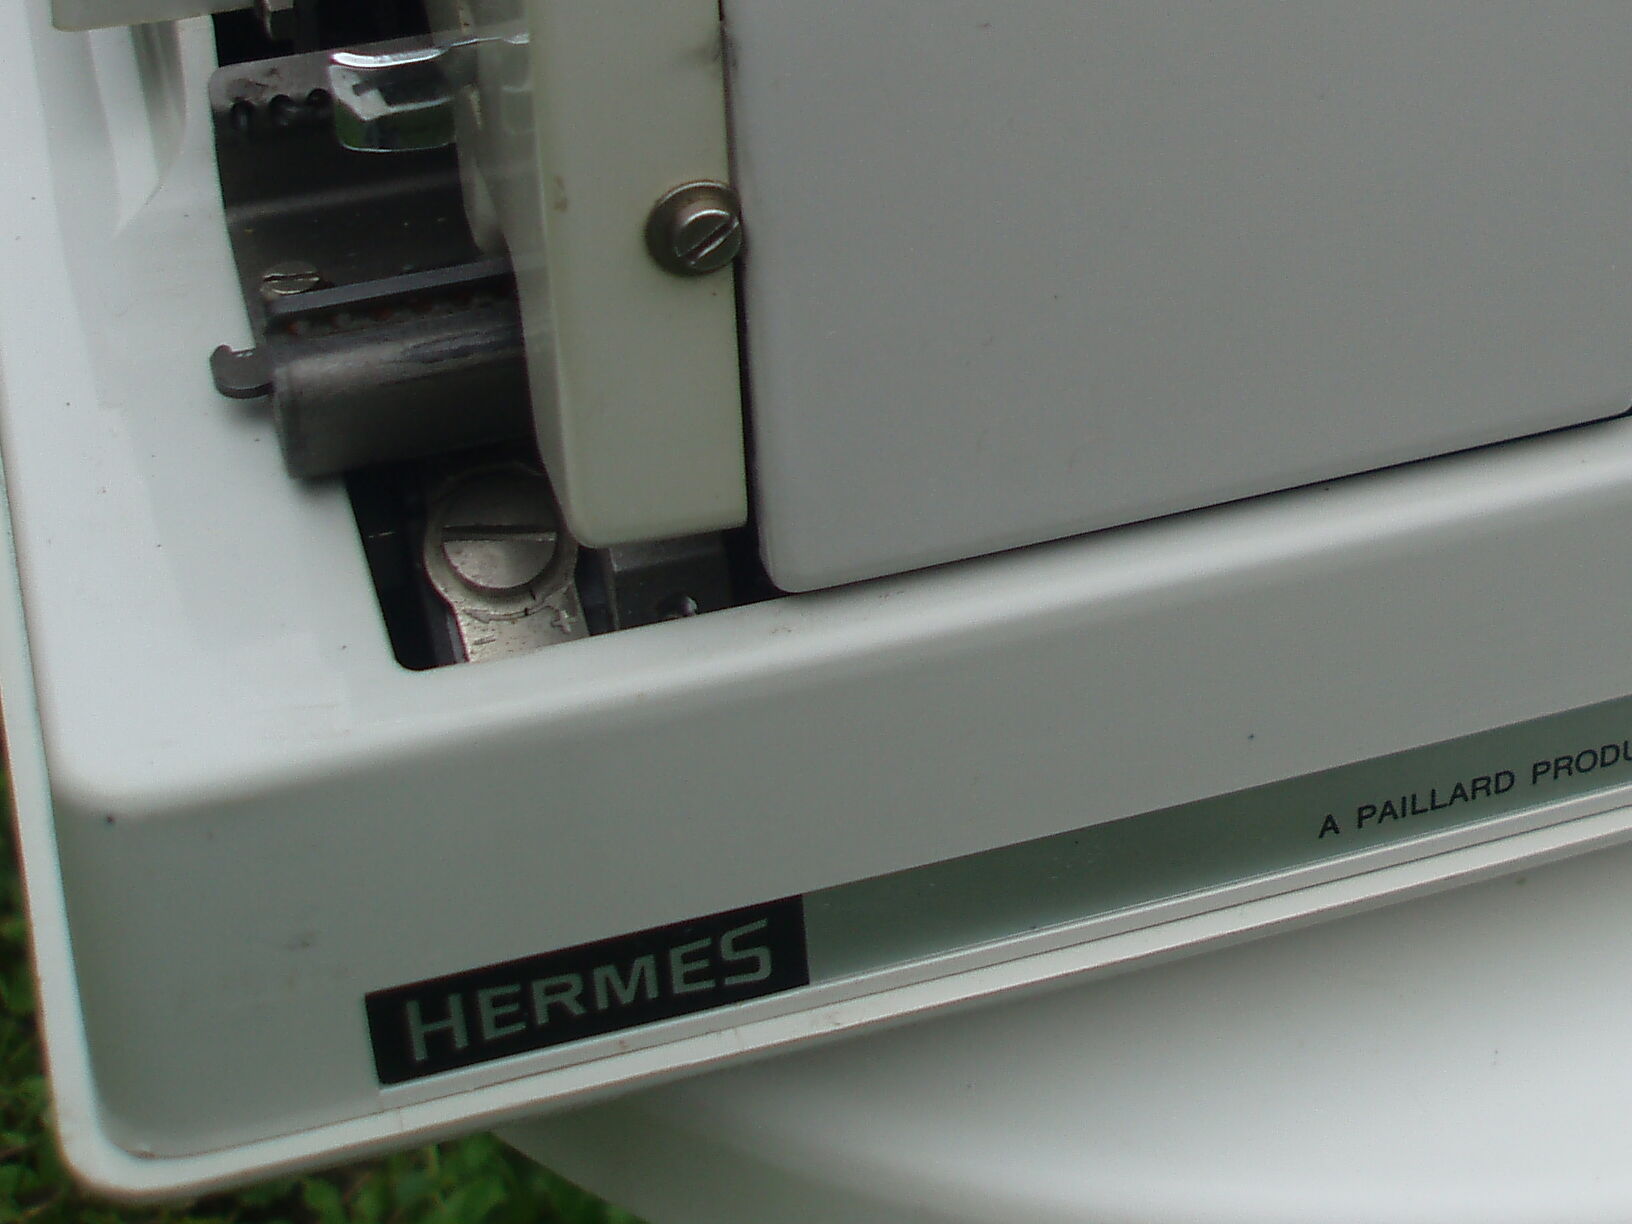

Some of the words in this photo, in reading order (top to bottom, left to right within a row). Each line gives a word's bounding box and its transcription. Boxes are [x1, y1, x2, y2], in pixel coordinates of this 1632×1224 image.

[1317, 813, 1341, 840] A
[1356, 769, 1516, 830] PAILLARD
[404, 917, 774, 1062] HERMES
